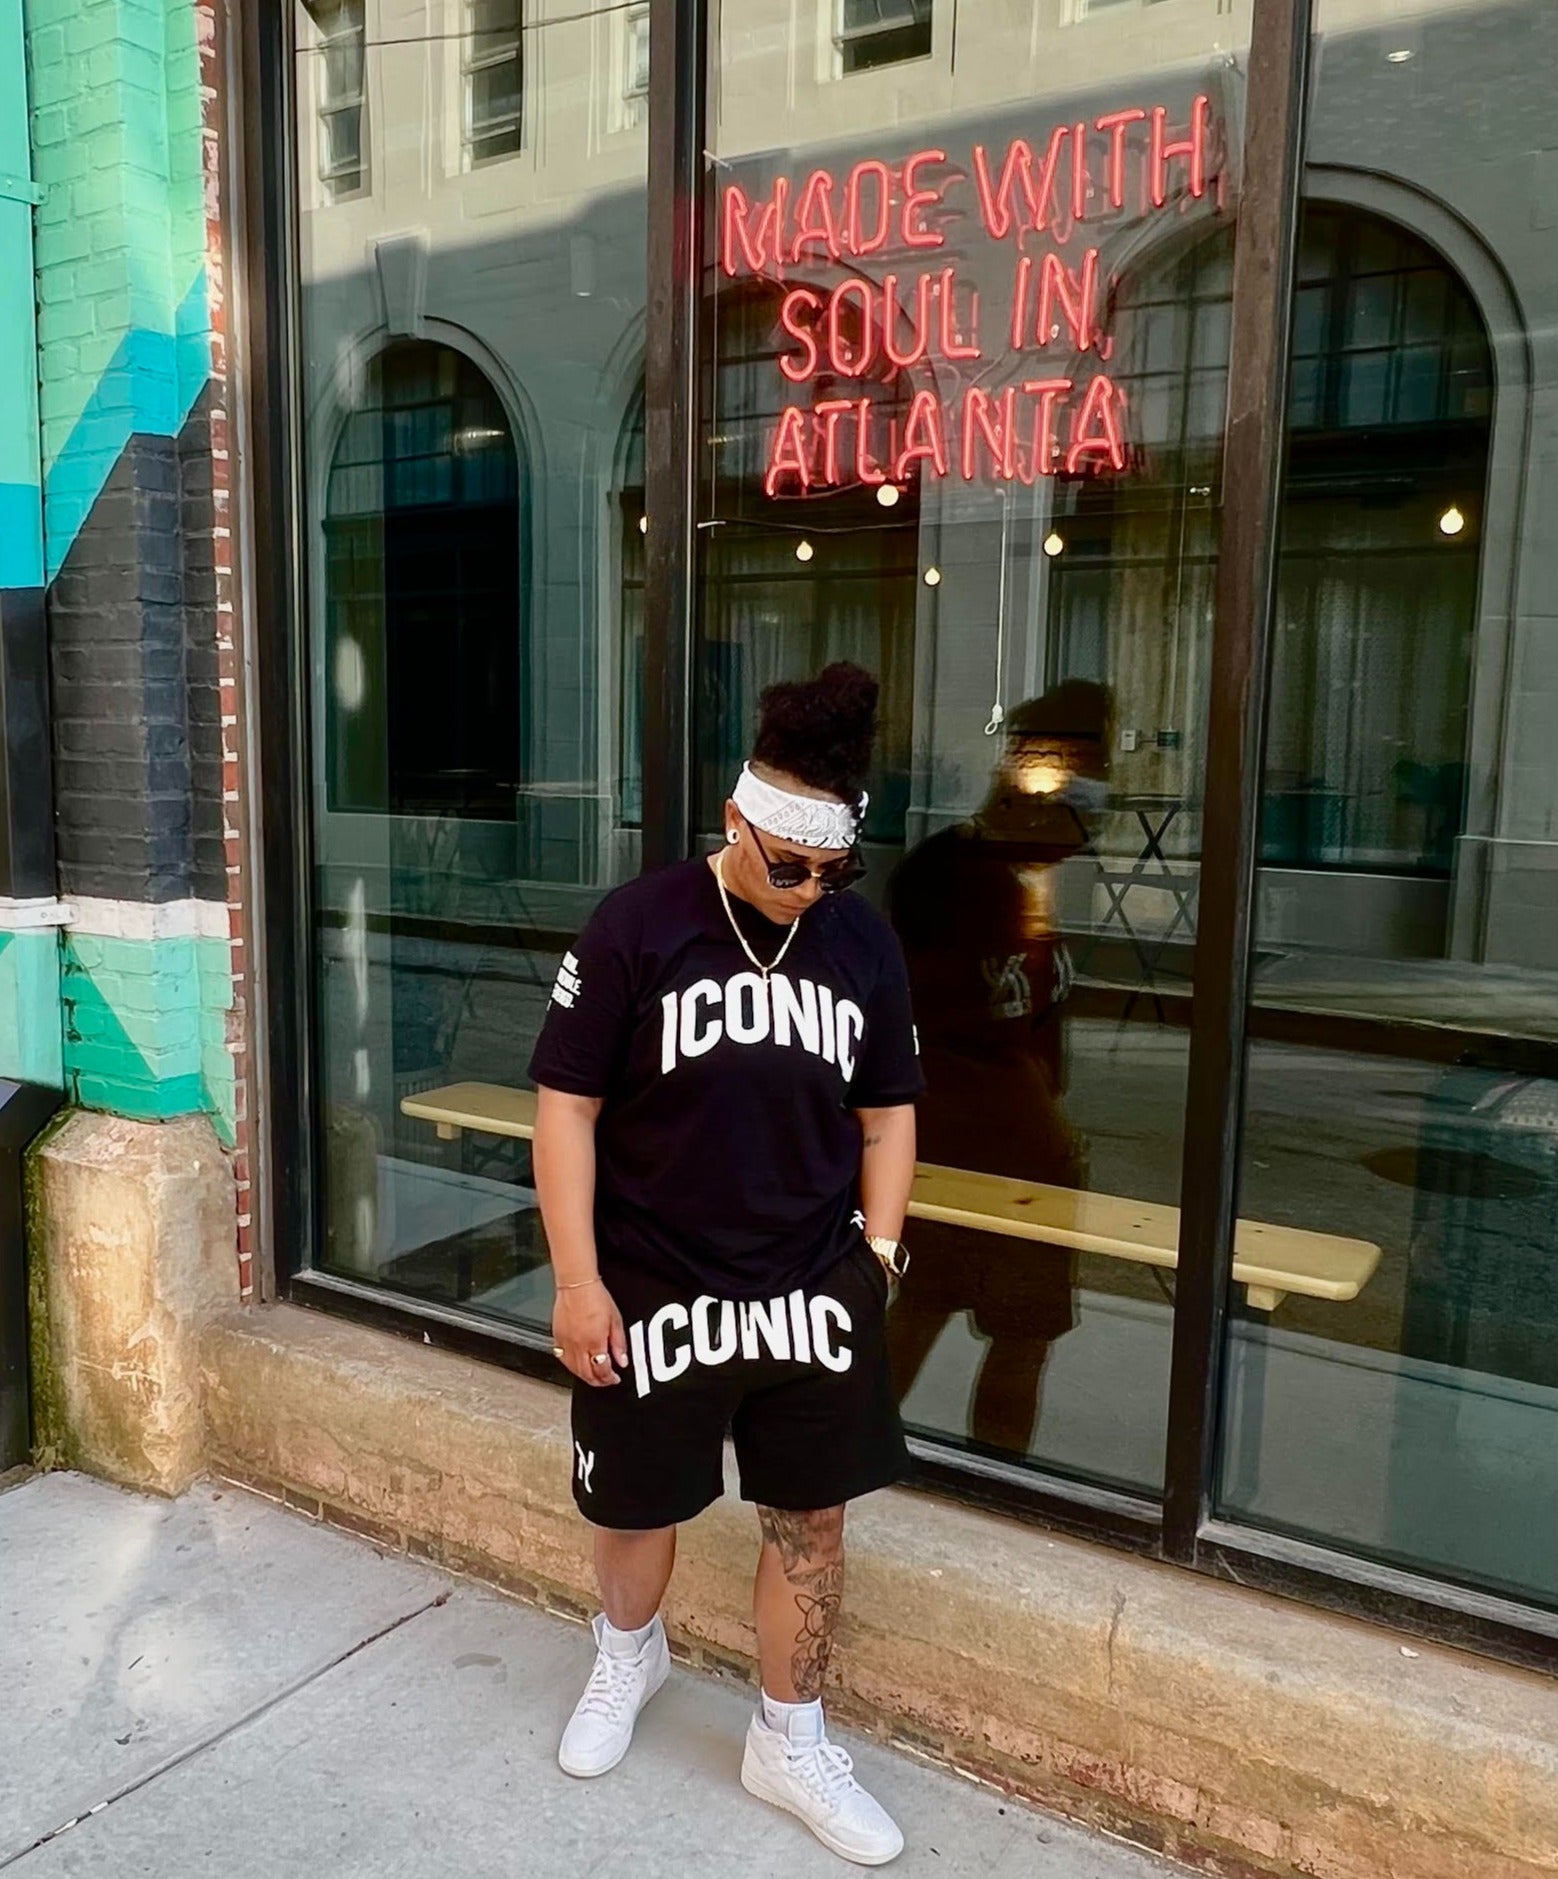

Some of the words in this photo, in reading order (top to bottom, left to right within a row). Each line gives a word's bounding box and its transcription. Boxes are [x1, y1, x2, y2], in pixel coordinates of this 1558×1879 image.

[722, 149, 946, 277] MADE
[973, 94, 1209, 239] WITH
[779, 267, 982, 382] SOUL
[1010, 247, 1099, 352] IN
[764, 374, 1126, 499] ATLANTA
[660, 971, 864, 1083] ICONIC
[629, 1289, 853, 1399] ICONIC
